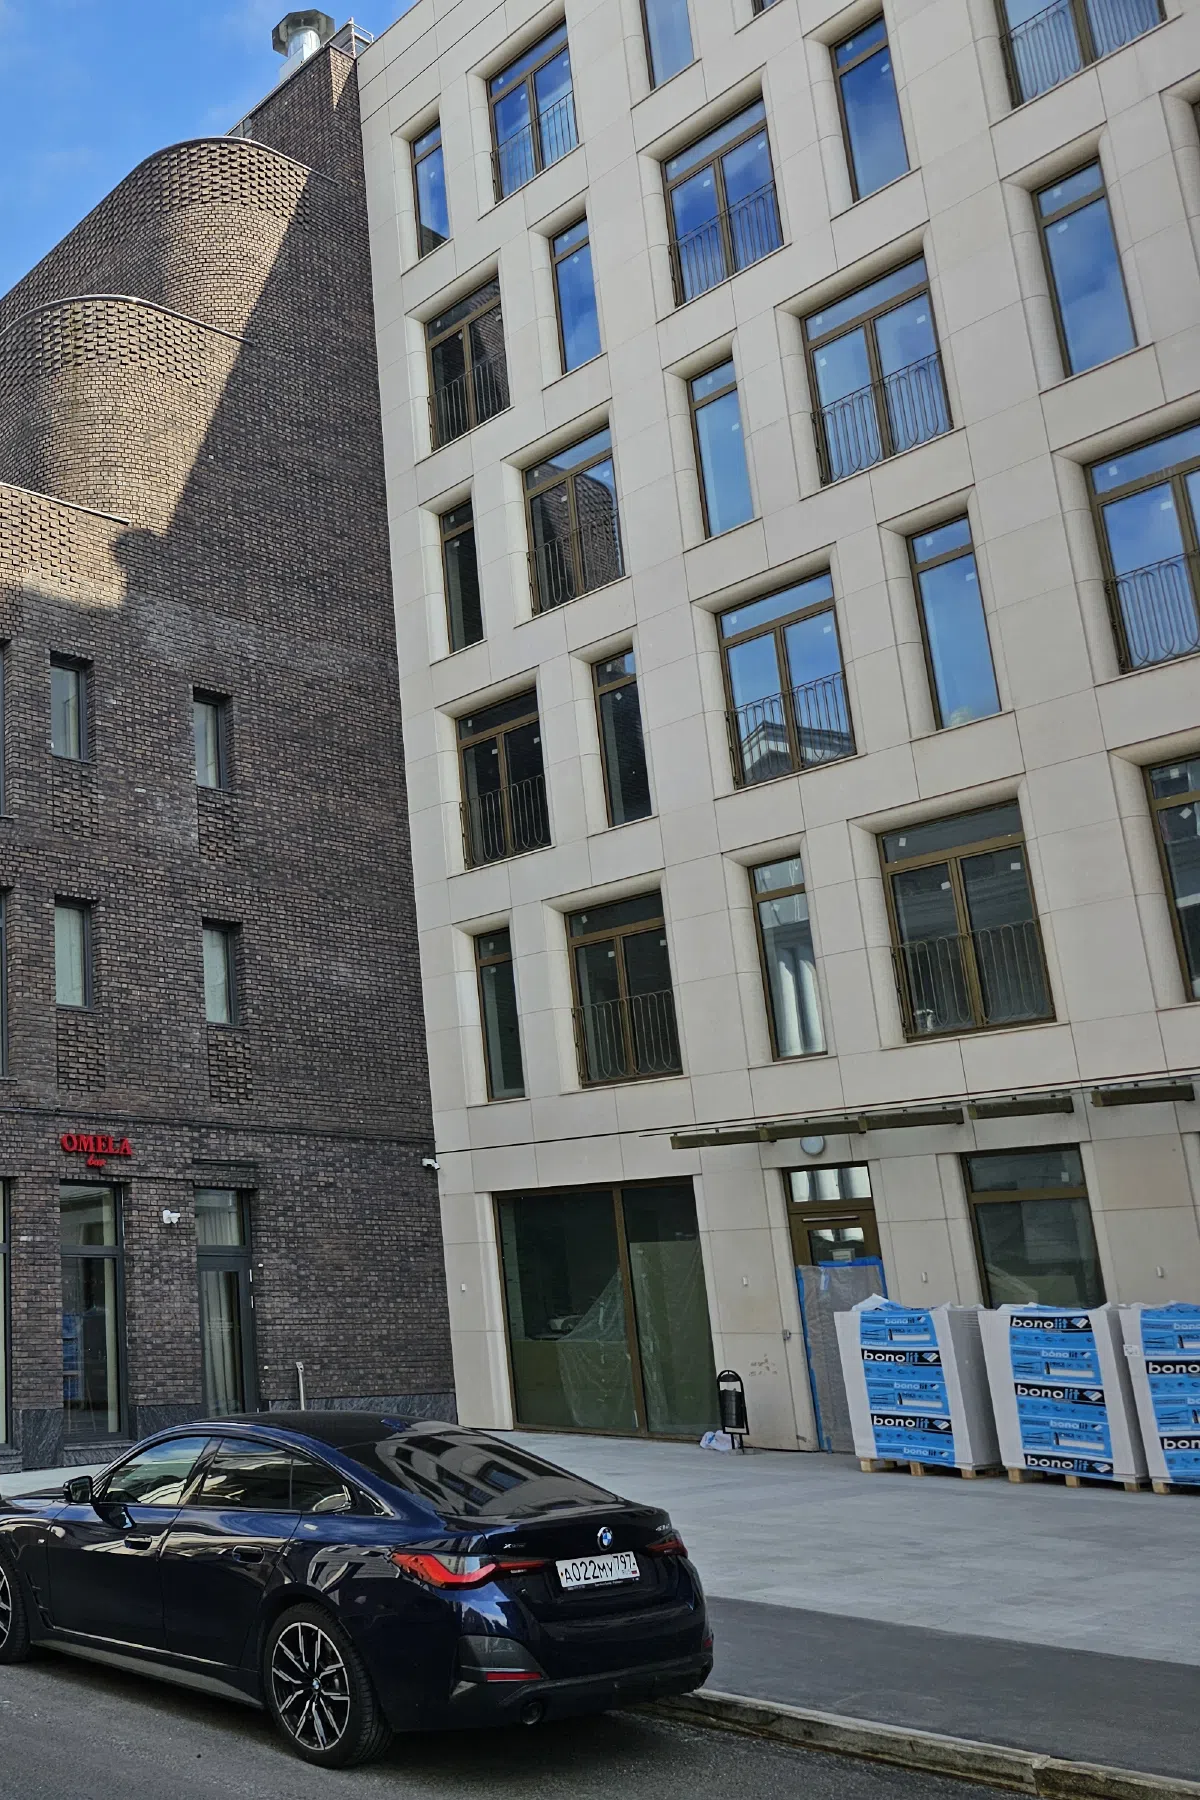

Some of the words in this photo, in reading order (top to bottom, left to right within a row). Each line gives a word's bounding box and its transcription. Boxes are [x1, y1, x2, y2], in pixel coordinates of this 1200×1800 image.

[61, 1133, 132, 1155] OMELA
[1012, 1317, 1068, 1329] bonolit
[863, 1350, 919, 1362] bonolit
[1148, 1361, 1200, 1374] bono
[1017, 1384, 1080, 1400] bonolit
[873, 1415, 929, 1429] bonolit
[1027, 1455, 1089, 1471] bonolit
